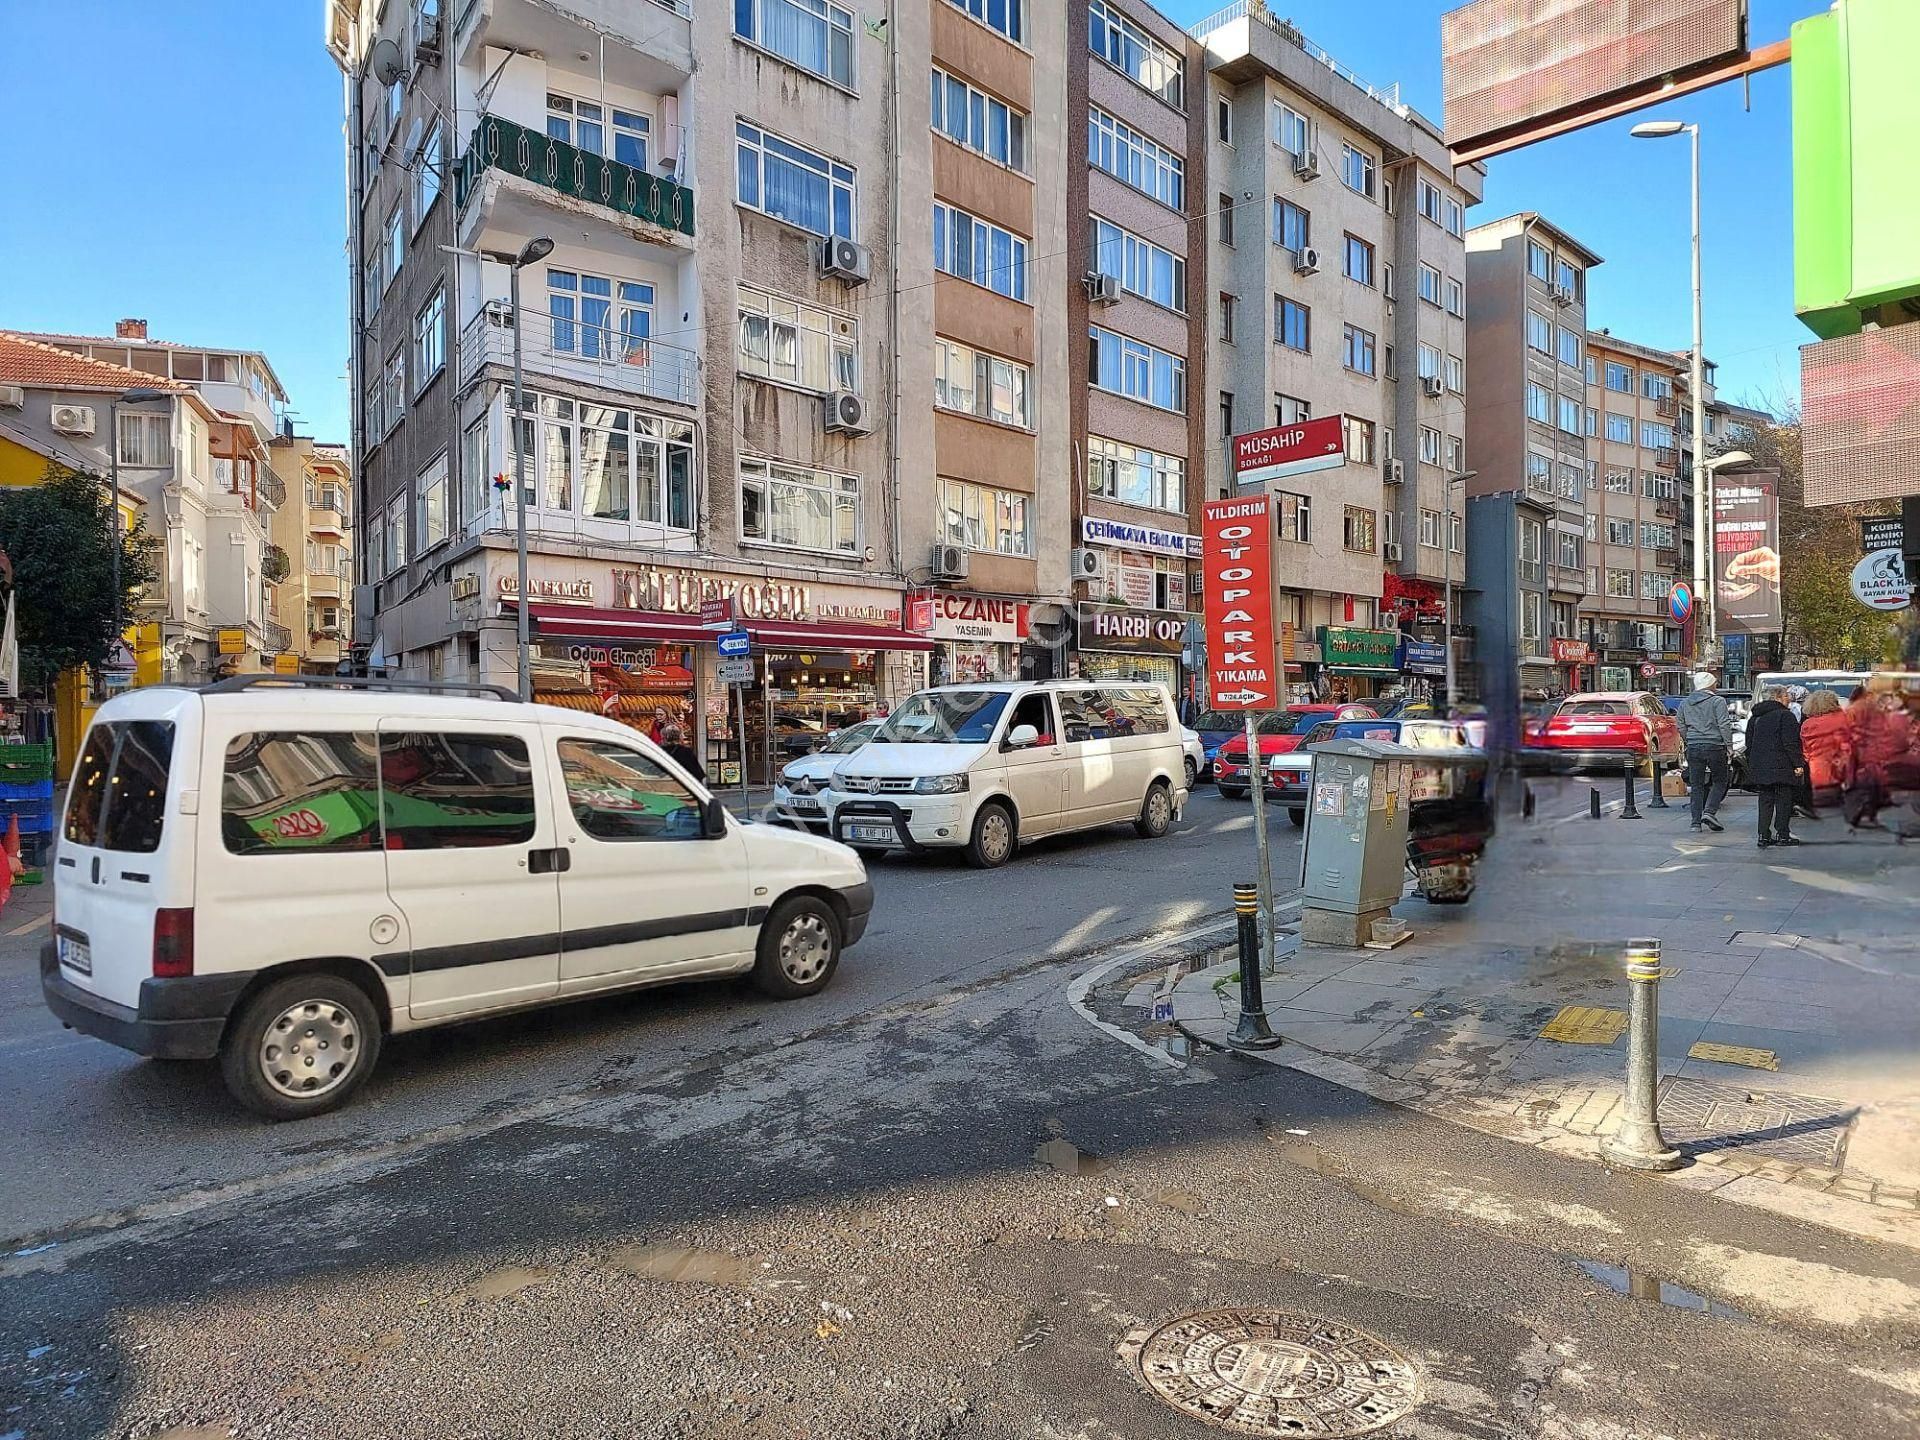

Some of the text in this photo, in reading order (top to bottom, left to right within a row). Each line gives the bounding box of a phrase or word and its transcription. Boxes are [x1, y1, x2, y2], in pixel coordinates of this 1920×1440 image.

[1240, 430, 1305, 456] MÜSAHİP
[1240, 455, 1272, 468] SOKAĞI
[1206, 502, 1266, 520] YILDIRIM
[1086, 520, 1147, 544] ÇETİNKAYA
[1149, 531, 1185, 550] EMLAK
[1716, 532, 1760, 543] BİLİYORSUN
[499, 576, 539, 593] ODN
[1860, 580, 1893, 589] BLACK
[1218, 526, 1256, 664] OTOPARK
[932, 593, 1015, 624] ECZANE
[955, 625, 992, 637] YASEMİN
[1094, 614, 1150, 638] HARBİ
[570, 645, 656, 667] Odun Ekmeği
[1216, 668, 1267, 683] YIKAMA
[1238, 693, 1256, 701] AÇIK
